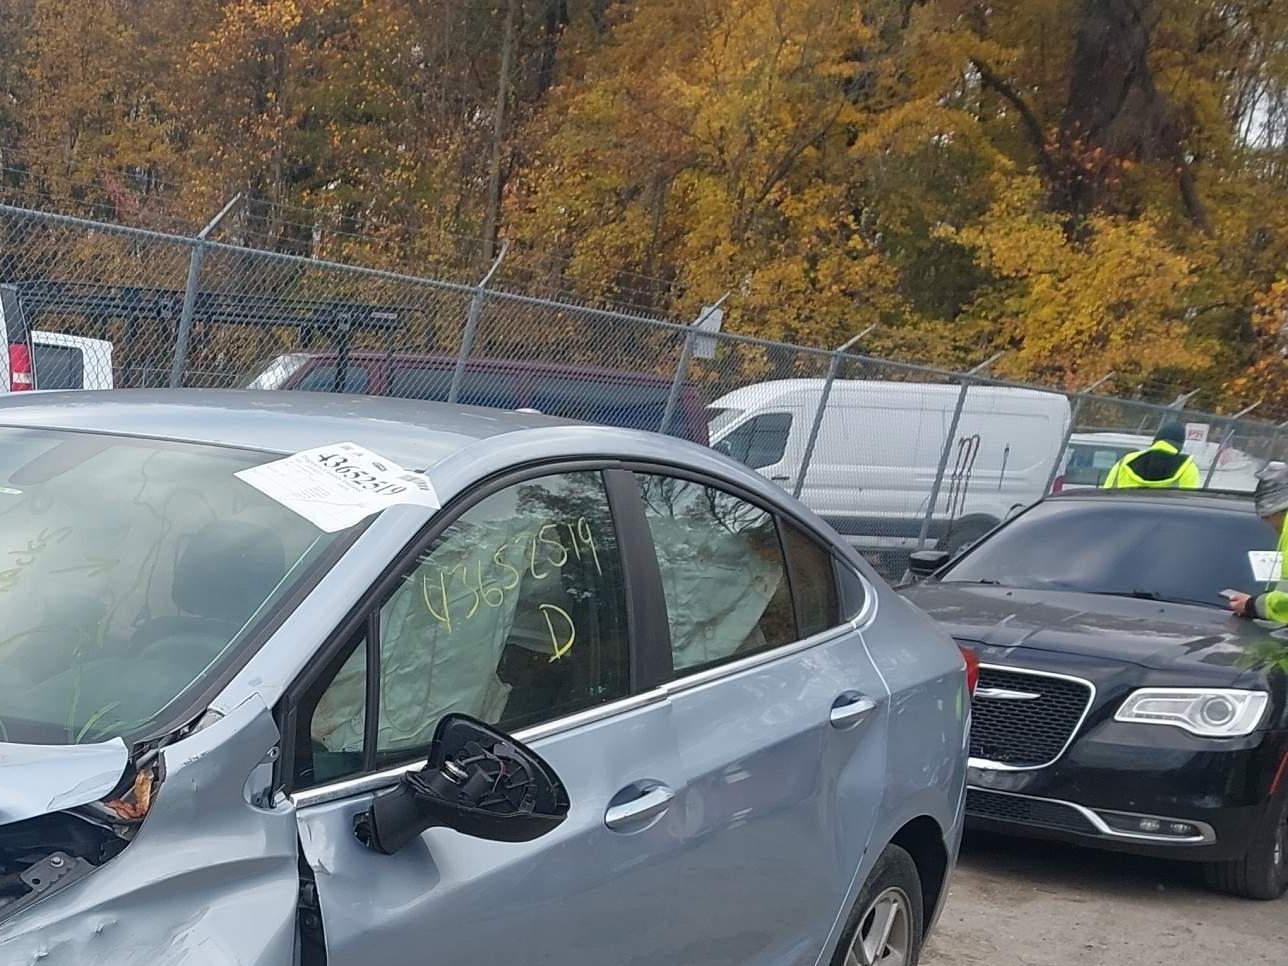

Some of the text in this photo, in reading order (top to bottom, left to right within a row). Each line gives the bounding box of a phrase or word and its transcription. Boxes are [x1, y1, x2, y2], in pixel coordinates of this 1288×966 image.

[318, 453, 408, 496] 43652519
[423, 517, 603, 634] 43652519
[539, 604, 576, 663] D
